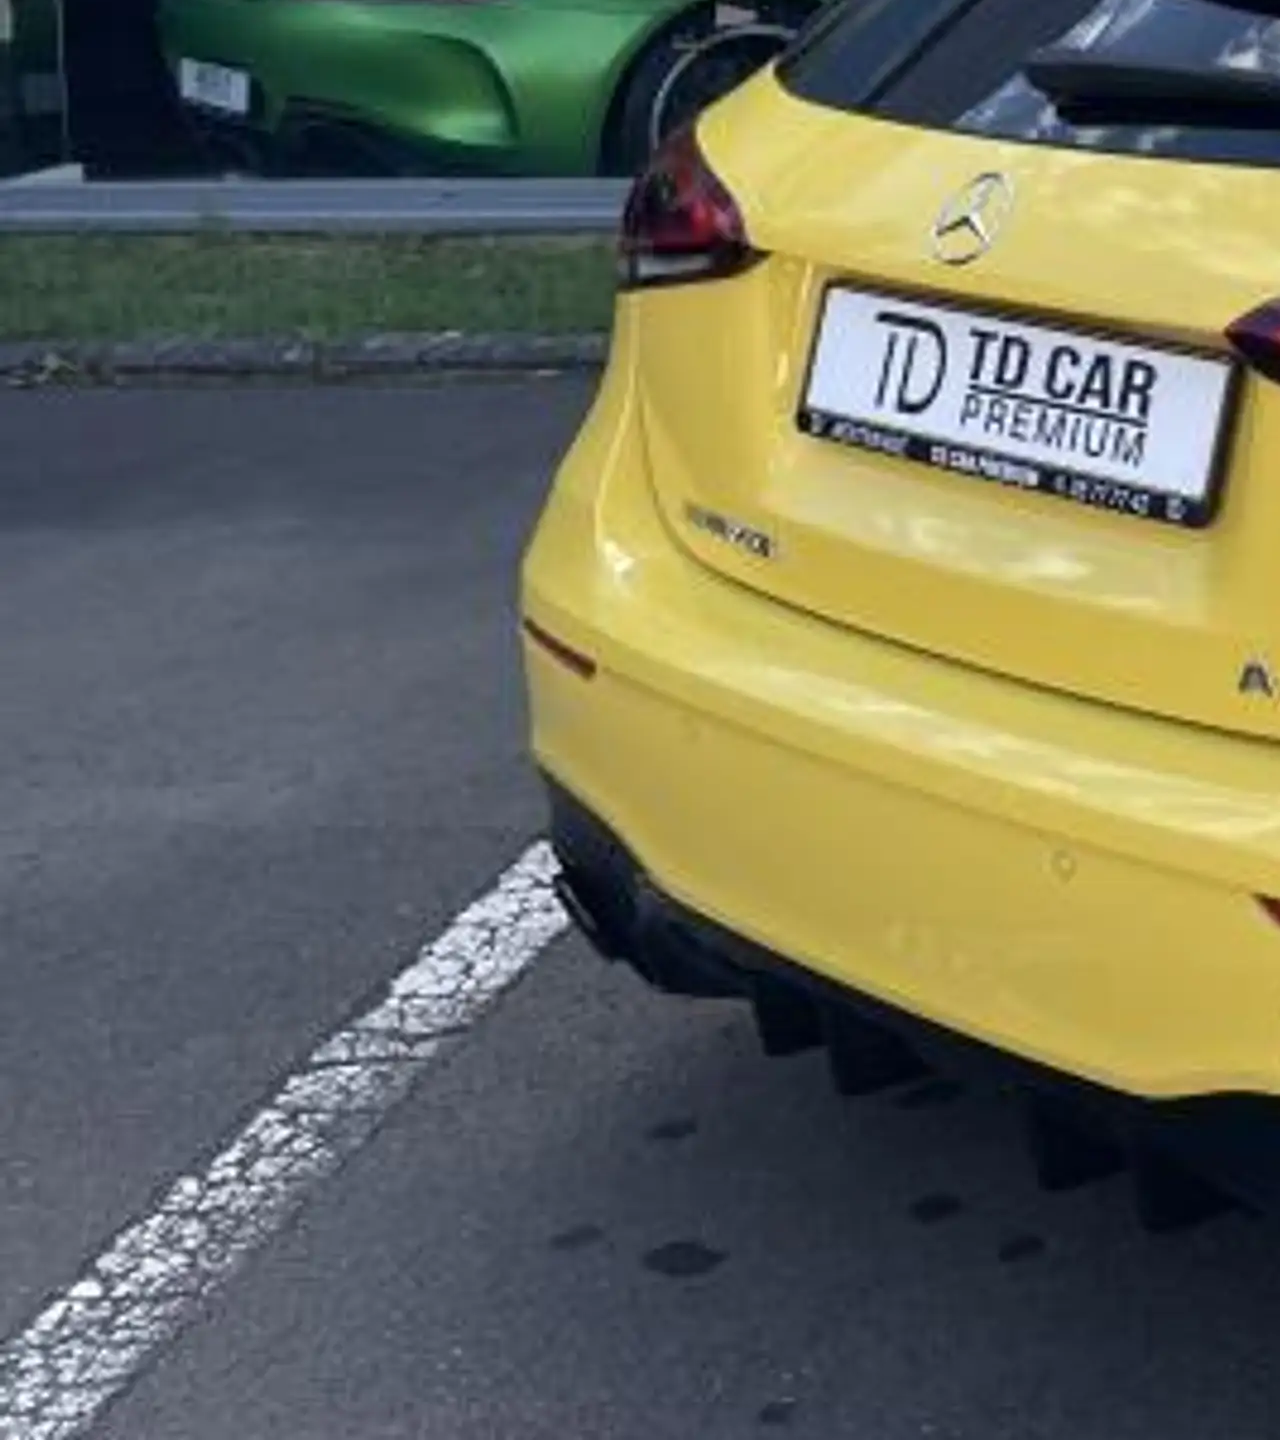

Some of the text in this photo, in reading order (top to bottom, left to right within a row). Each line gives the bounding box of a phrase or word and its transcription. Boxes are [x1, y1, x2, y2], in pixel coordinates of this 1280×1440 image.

[968, 329, 1157, 420] TD CAR
[959, 395, 1148, 470] PREMIUM
[1238, 657, 1274, 698] A
